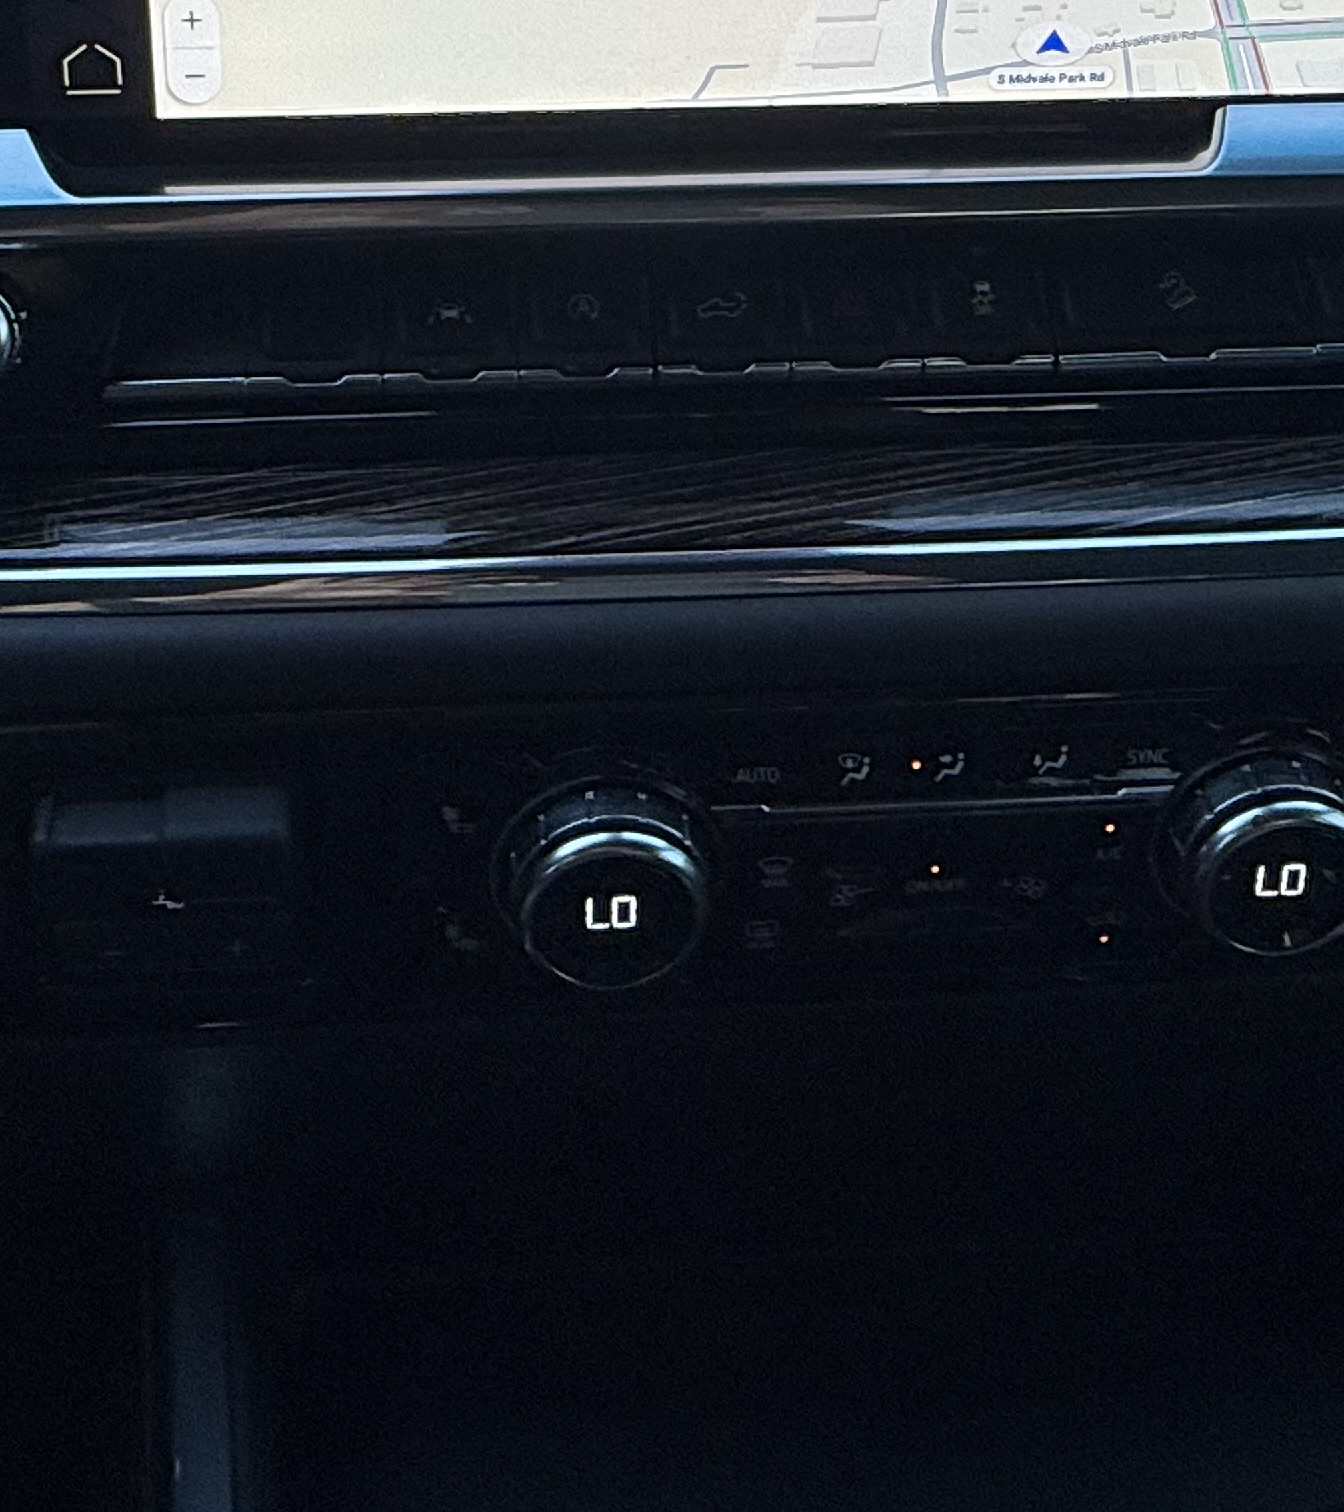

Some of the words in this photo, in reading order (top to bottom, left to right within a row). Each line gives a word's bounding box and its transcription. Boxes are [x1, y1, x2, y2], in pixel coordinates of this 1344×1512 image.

[996, 74, 1006, 85] S
[1009, 73, 1056, 84] Midvale
[1058, 72, 1087, 84] Park
[1089, 72, 1105, 82] Rd
[1126, 748, 1170, 766] SYNC
[736, 766, 781, 785] AUTO
[1255, 863, 1307, 897] LO
[585, 895, 638, 931] LO
